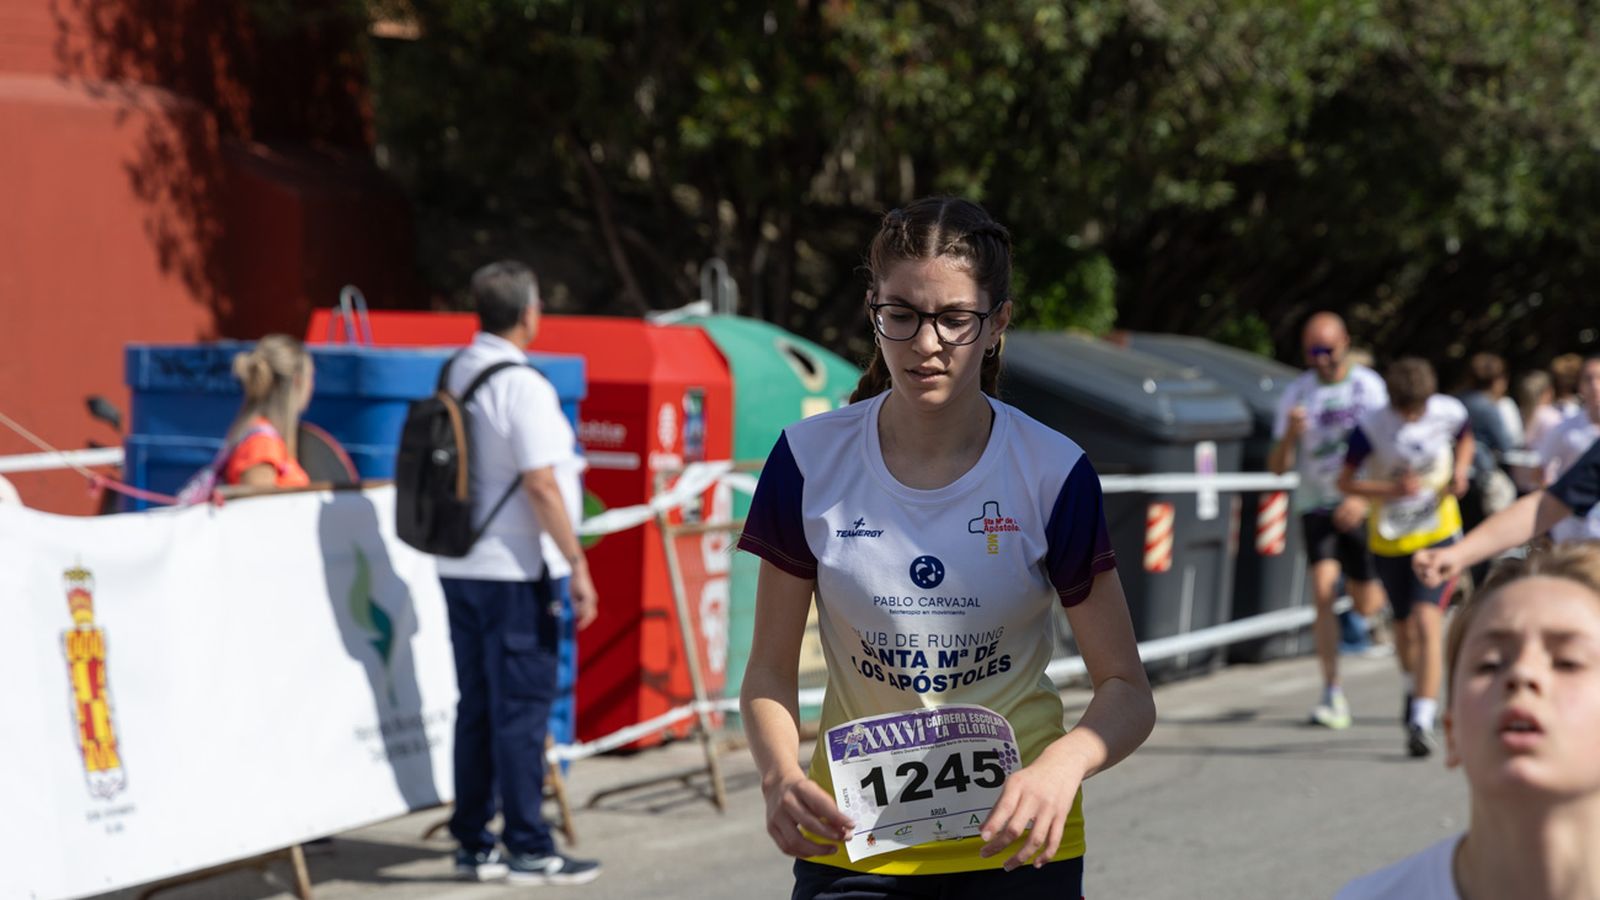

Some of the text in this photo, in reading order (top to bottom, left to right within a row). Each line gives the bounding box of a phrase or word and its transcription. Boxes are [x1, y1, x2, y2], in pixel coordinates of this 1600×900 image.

[983, 524, 1020, 533] Apóstole
[986, 534, 999, 555] MCI
[873, 596, 982, 608] PABLO CARVAJAL
[895, 633, 919, 648] DE
[928, 626, 1004, 648] RUNNING
[938, 649, 969, 668] Mª
[974, 640, 999, 663] DE
[889, 655, 1012, 693] APÓSTOLES
[865, 713, 1005, 750] XXXVI CARRERA ESCOLAR
[936, 723, 998, 739] LA GLORIA
[860, 751, 1006, 807] 1245
